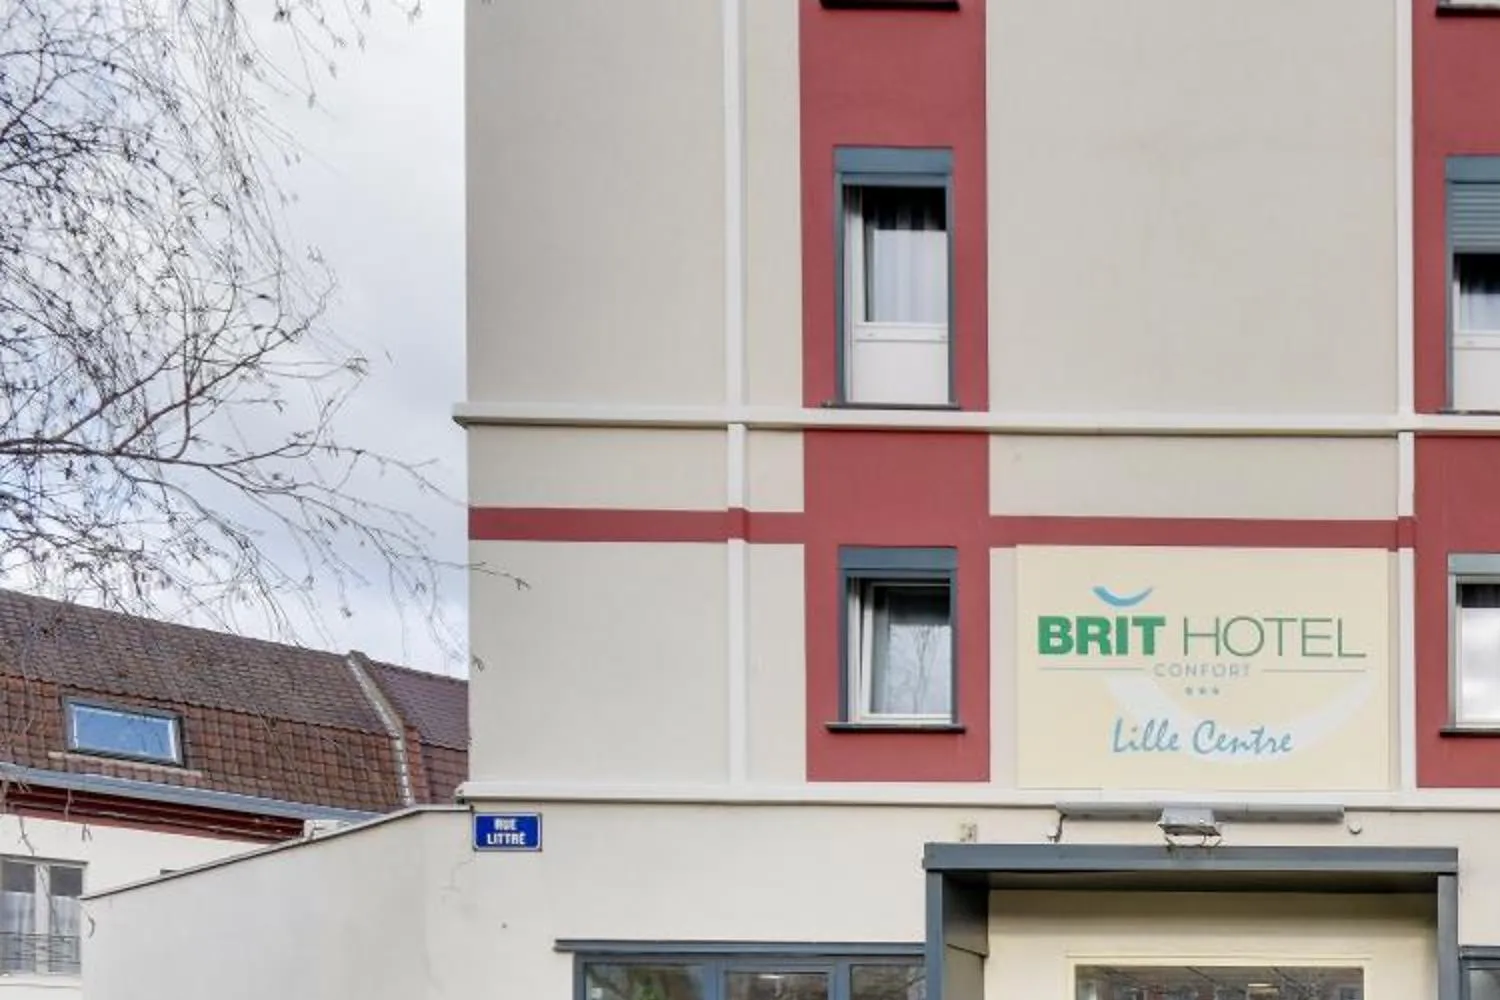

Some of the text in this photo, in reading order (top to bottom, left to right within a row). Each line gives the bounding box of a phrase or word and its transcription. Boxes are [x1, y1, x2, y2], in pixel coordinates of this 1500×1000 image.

[1037, 616, 1366, 658] BRIT HOTEL
[1154, 663, 1251, 678] CONFORT
[1112, 717, 1292, 755] Lille Centre
